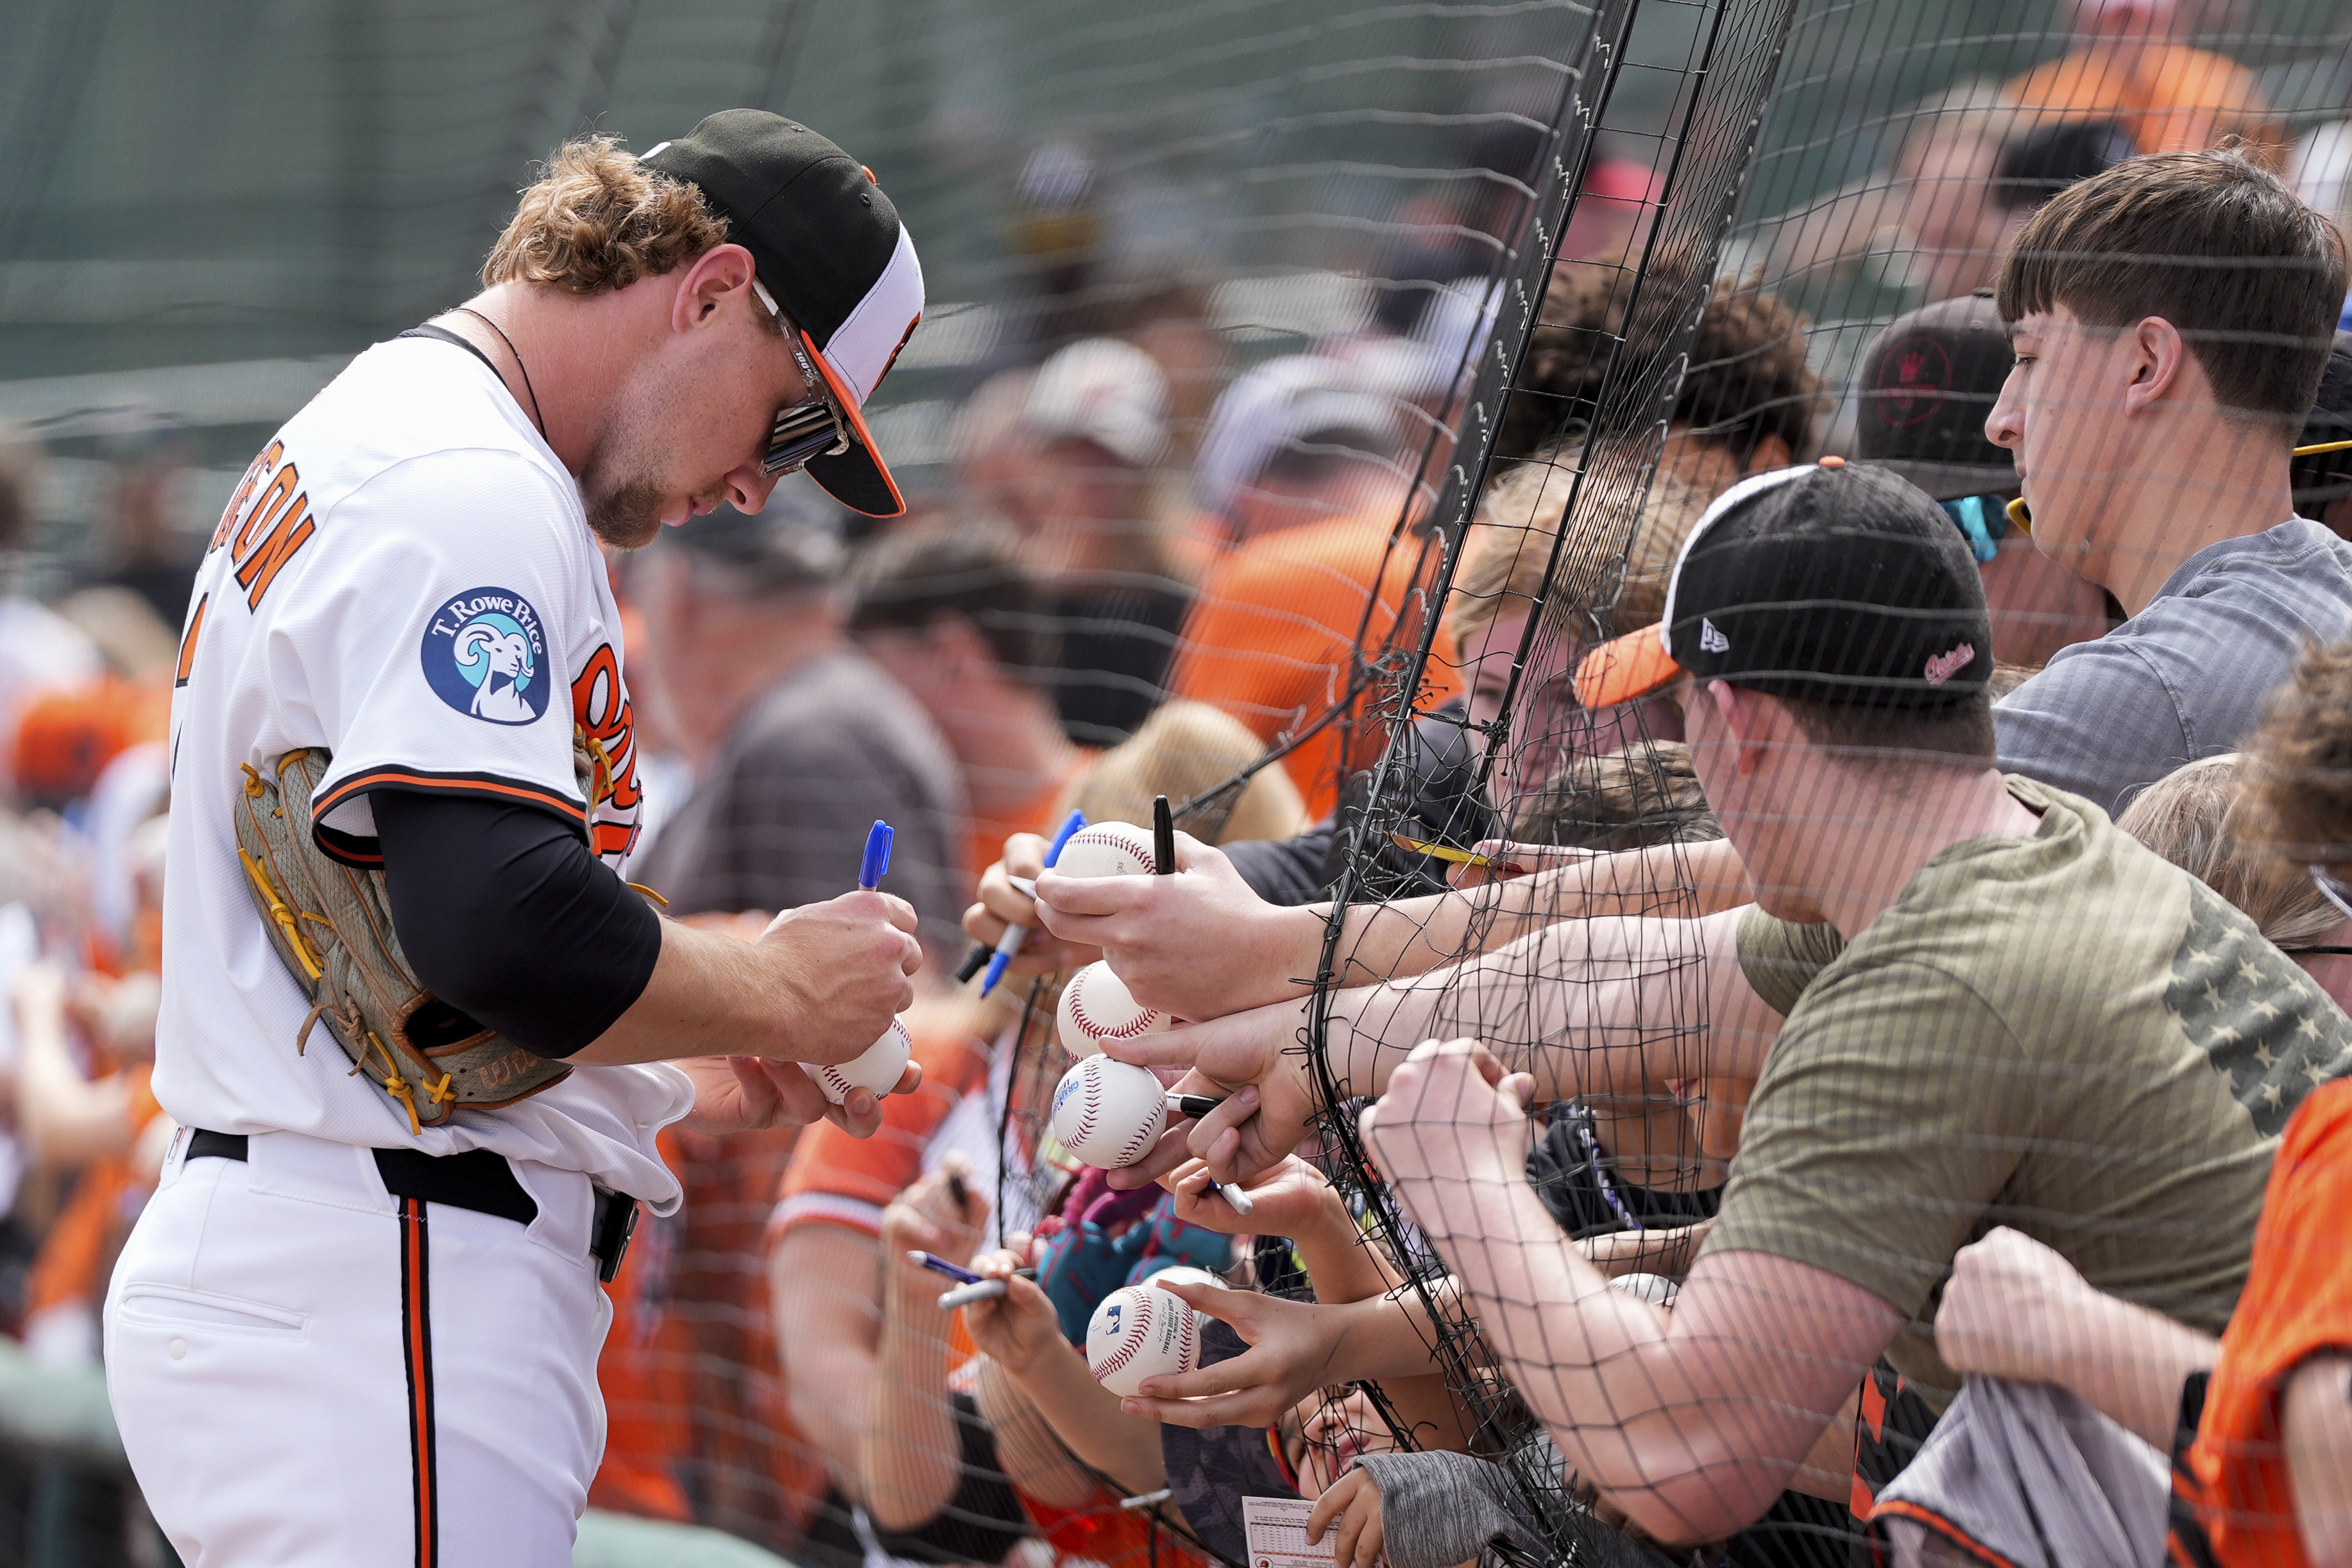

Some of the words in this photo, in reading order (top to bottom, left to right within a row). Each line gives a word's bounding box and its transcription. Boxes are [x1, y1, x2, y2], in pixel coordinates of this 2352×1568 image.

[795, 351, 814, 379] 100%
[431, 618, 460, 638] T.
[448, 596, 515, 624] Rowe
[511, 598, 542, 655] Price
[1161, 1328, 1173, 1355] BASEBALL
